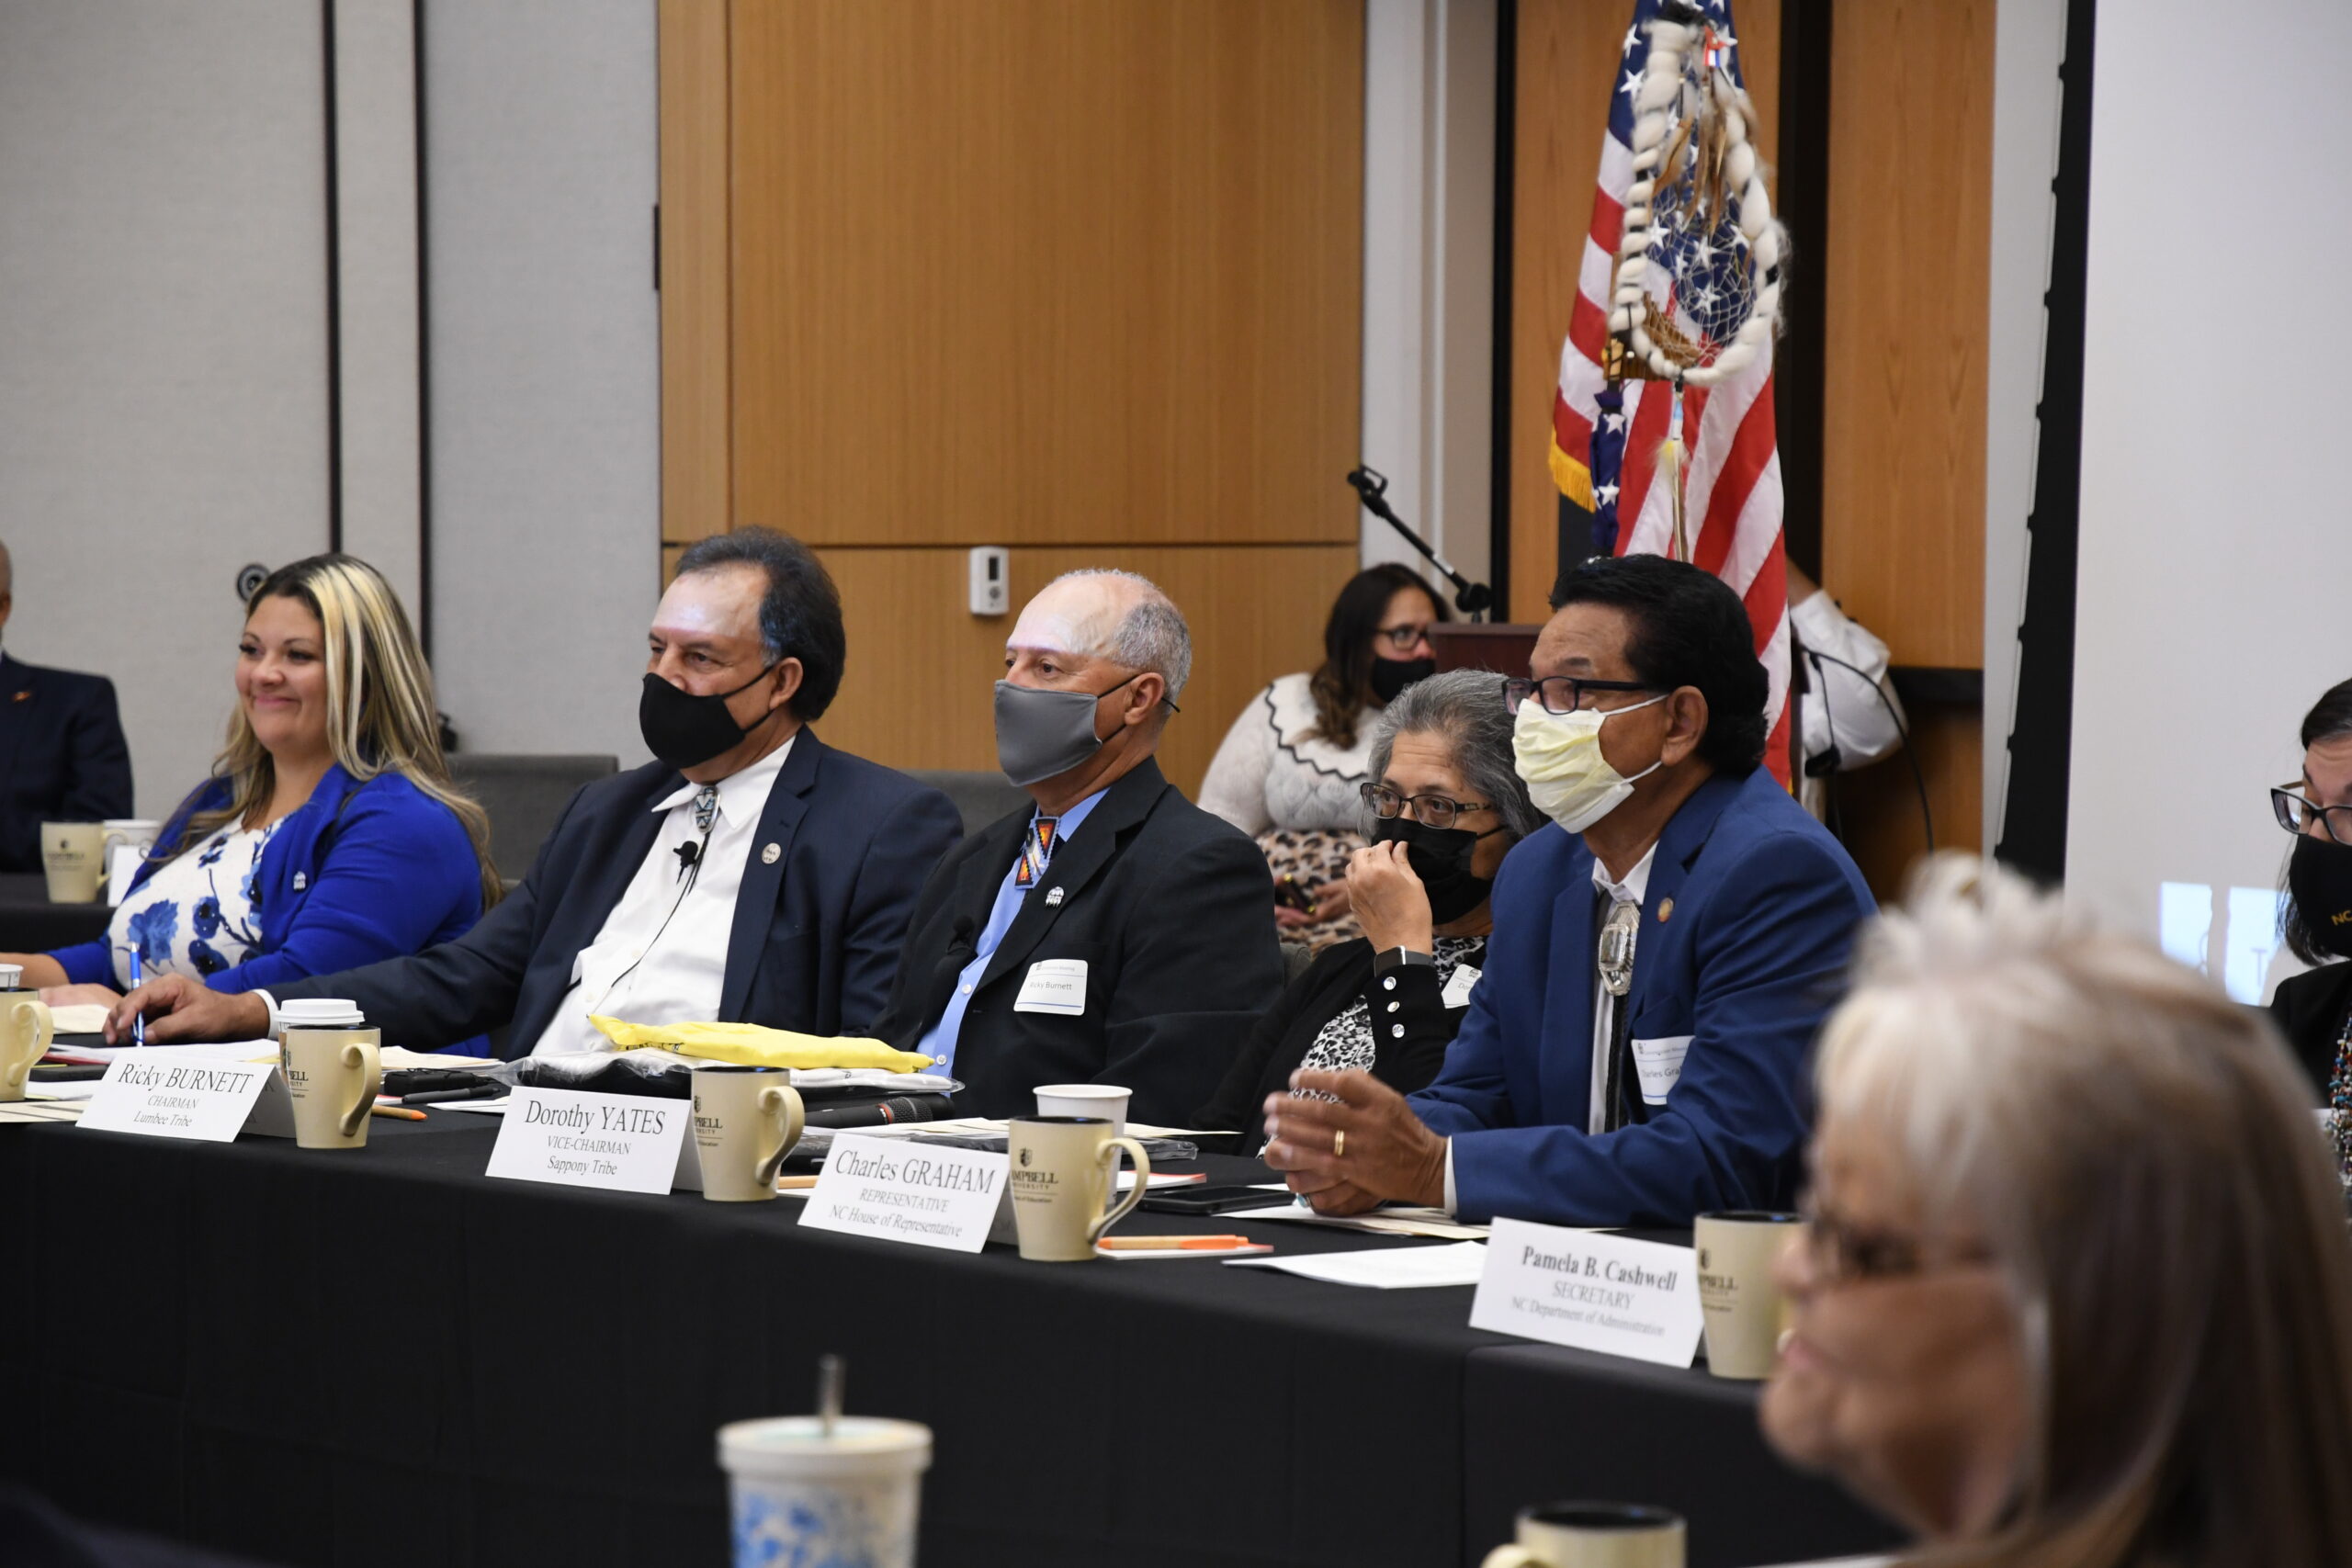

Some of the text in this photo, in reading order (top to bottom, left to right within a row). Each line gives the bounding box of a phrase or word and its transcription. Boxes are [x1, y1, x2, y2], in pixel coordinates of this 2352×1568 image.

[1045, 981, 1072, 990] Burnett
[118, 1063, 165, 1091] Ricky
[165, 1067, 254, 1094] BURNETT
[147, 1095, 200, 1110] CHAIRMAN
[525, 1100, 666, 1135] Dorothy YATES
[133, 1111, 192, 1127] Lumbee Tribe
[548, 1135, 631, 1155] VICE-CHAIRMAN
[548, 1156, 617, 1176] Sappony Tribe
[836, 1149, 996, 1194] Charles GRAHAM
[859, 1188, 950, 1213] REPRESENTATIVE
[829, 1204, 963, 1237] NC House of Representative
[1521, 1246, 1679, 1292] Pamela B. Cashwell
[1552, 1280, 1635, 1311] SECRETARY
[1511, 1296, 1666, 1337] NC Department of Administration
